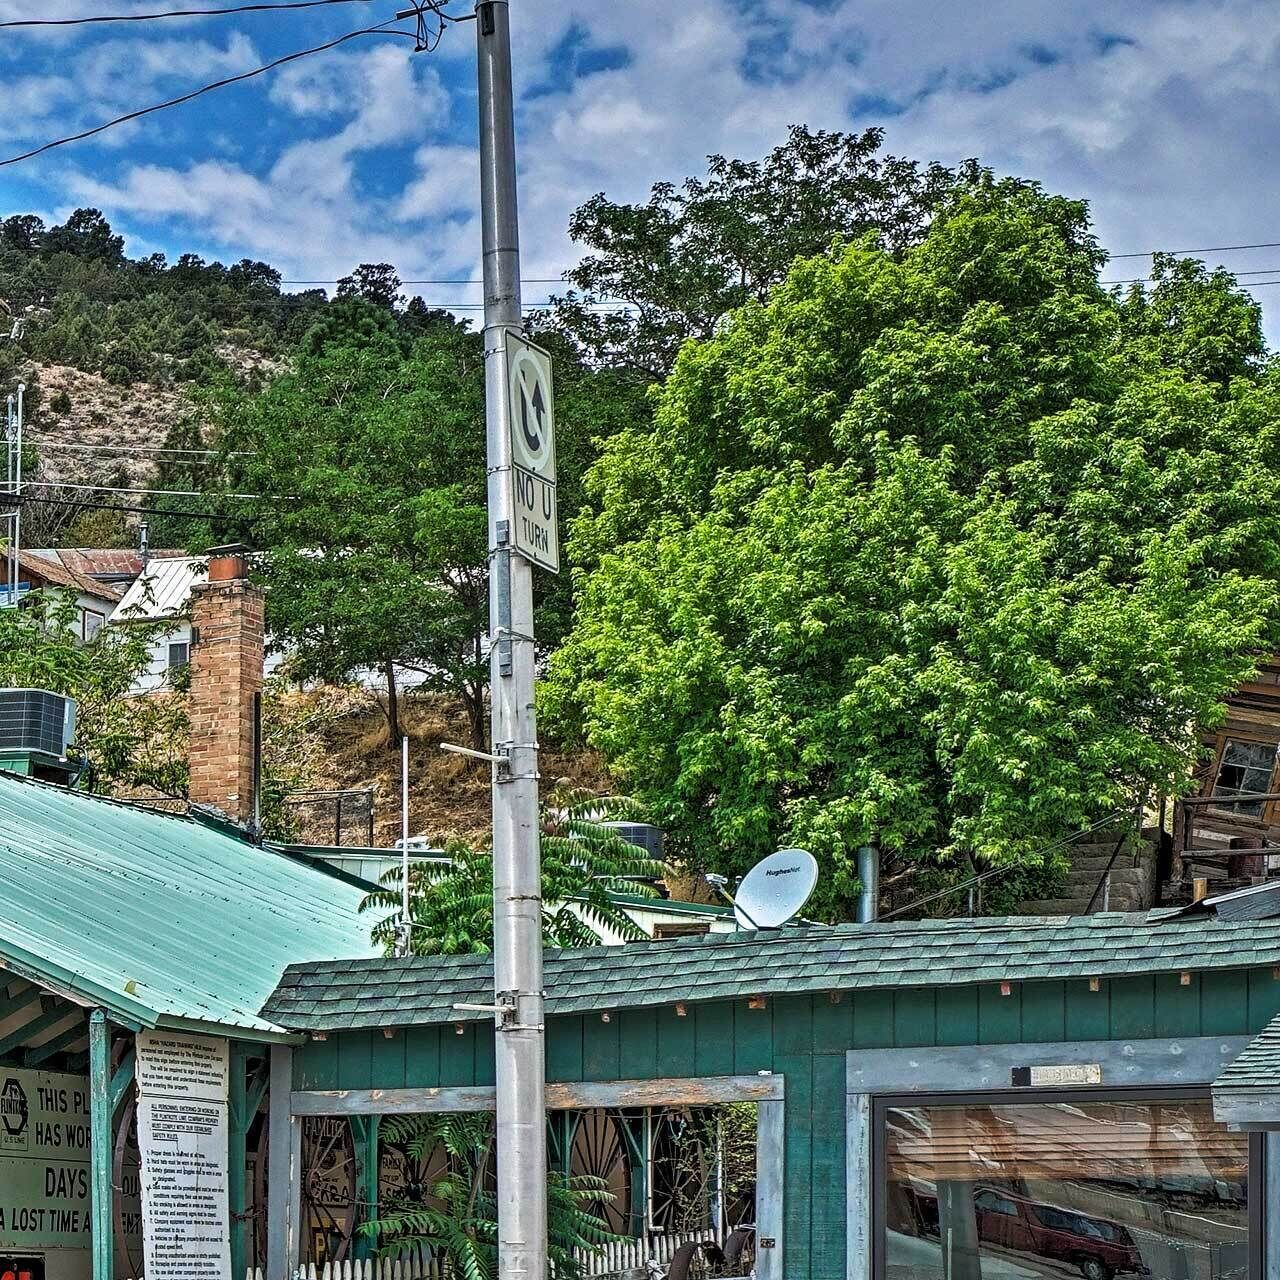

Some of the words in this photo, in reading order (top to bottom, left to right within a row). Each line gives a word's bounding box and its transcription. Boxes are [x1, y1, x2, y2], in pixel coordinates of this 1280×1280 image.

[516, 469, 535, 512] NO
[542, 482, 551, 521] U
[521, 516, 549, 554] TURN
[37, 1087, 68, 1114] THIS
[35, 1122, 62, 1147] HAS
[45, 1167, 88, 1199] DAYS
[12, 1207, 45, 1231] LOST
[49, 1209, 79, 1233] TIME
